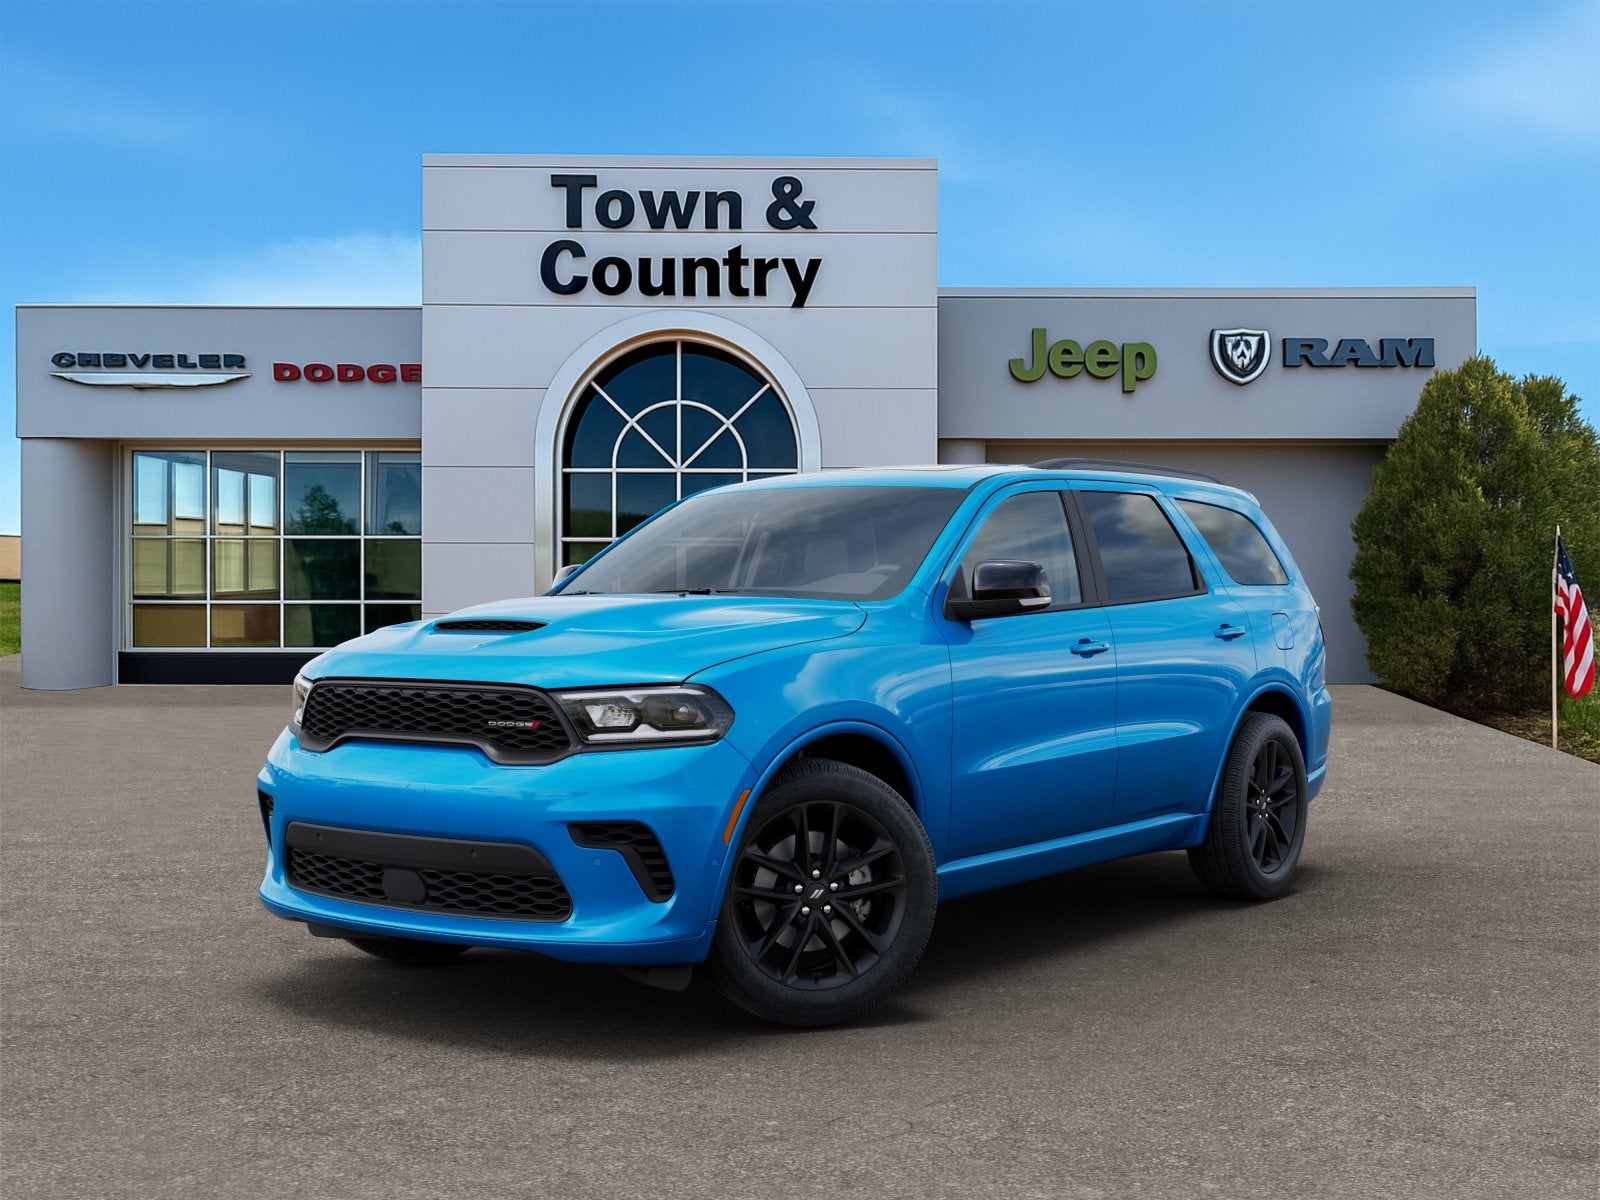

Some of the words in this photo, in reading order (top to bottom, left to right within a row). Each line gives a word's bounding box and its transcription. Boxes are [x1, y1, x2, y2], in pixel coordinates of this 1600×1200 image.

[550, 174, 742, 230] Town
[765, 175, 818, 230] &
[540, 239, 823, 308] Country
[273, 362, 422, 384] DODGE
[1009, 328, 1157, 393] Jeep
[1282, 337, 1436, 368] RAM
